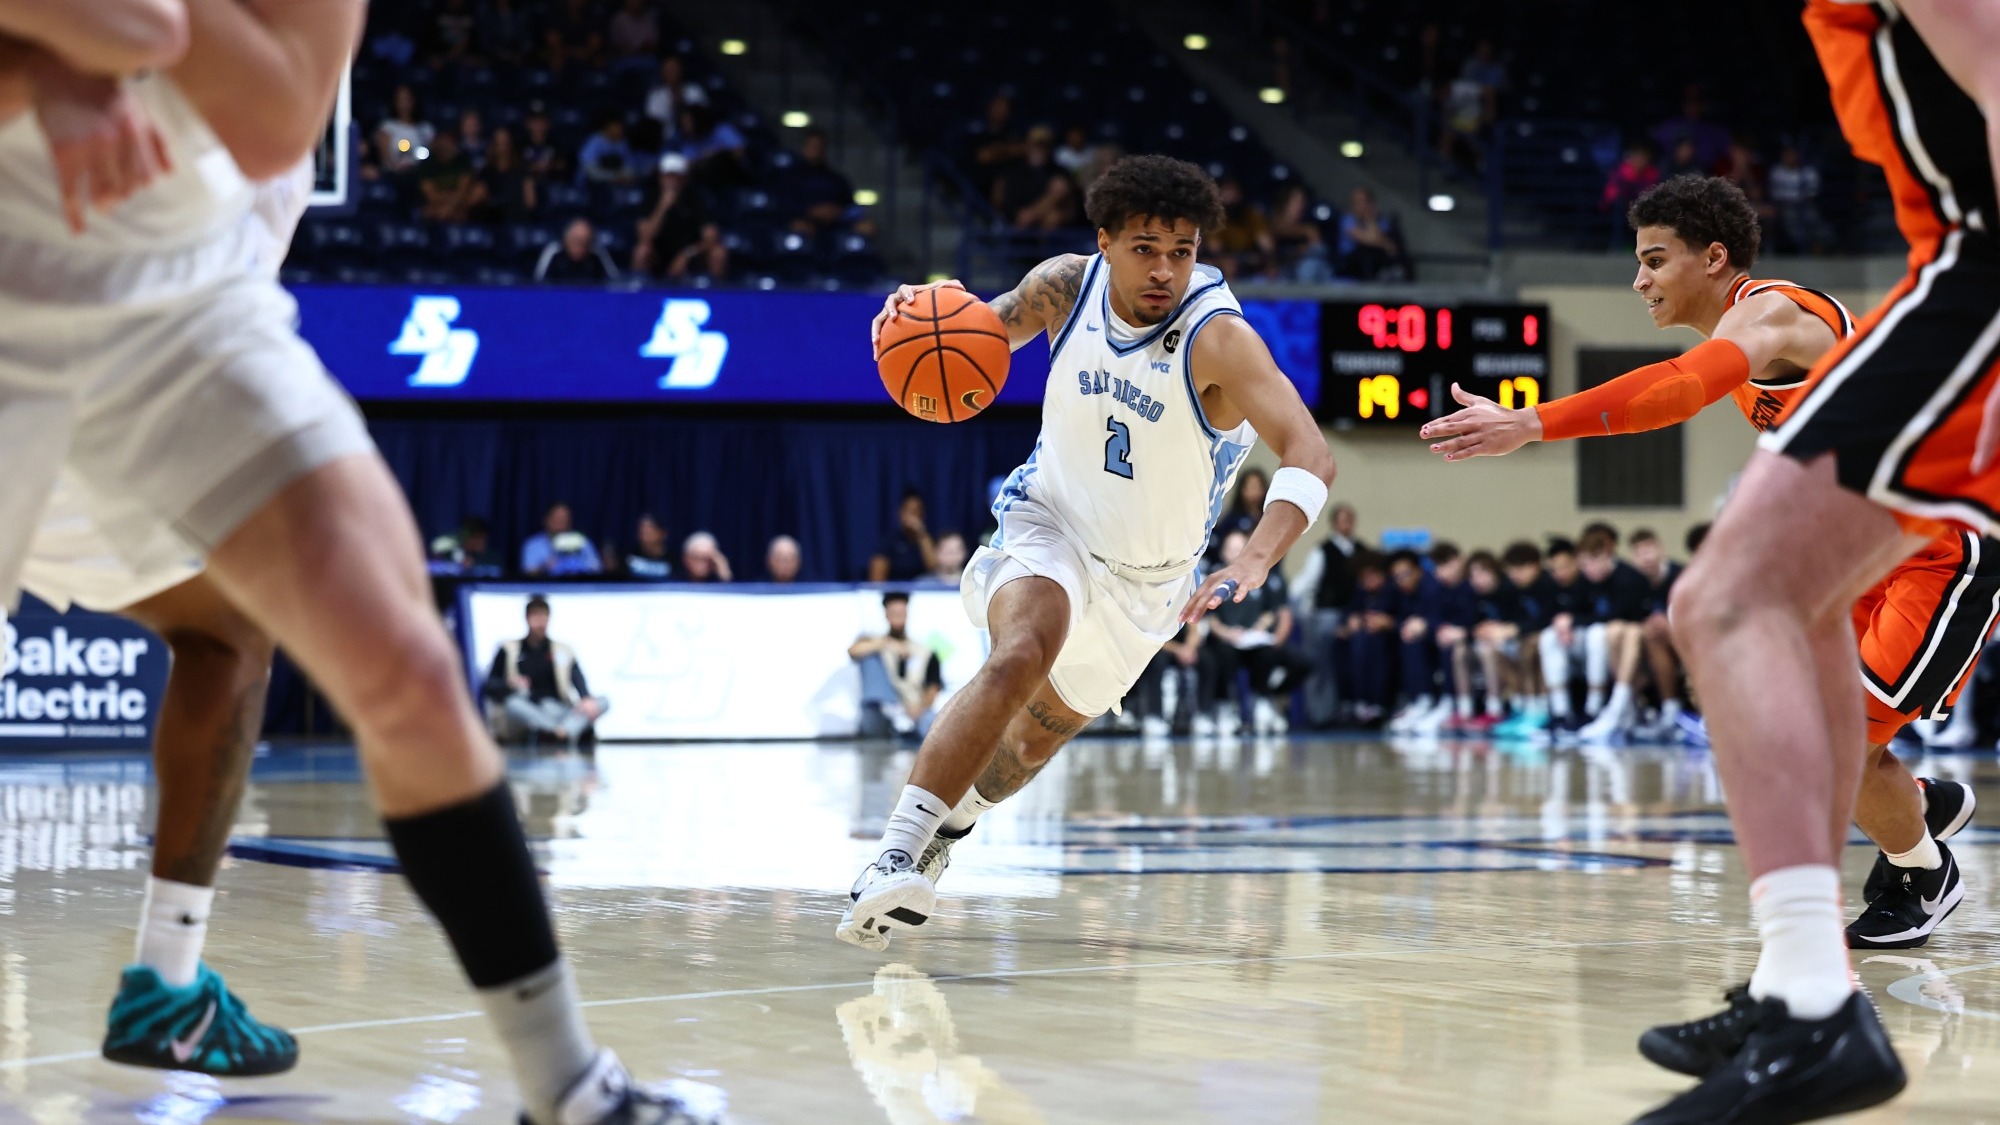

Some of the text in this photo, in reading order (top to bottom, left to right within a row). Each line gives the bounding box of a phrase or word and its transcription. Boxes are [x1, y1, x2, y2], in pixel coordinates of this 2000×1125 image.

[1358, 304, 1452, 351] 9:01
[1524, 315, 1538, 346] 1
[1359, 375, 1400, 419] 19
[1499, 376, 1539, 410] 17
[1104, 415, 1134, 480] 2
[0, 679, 147, 721] lectric
